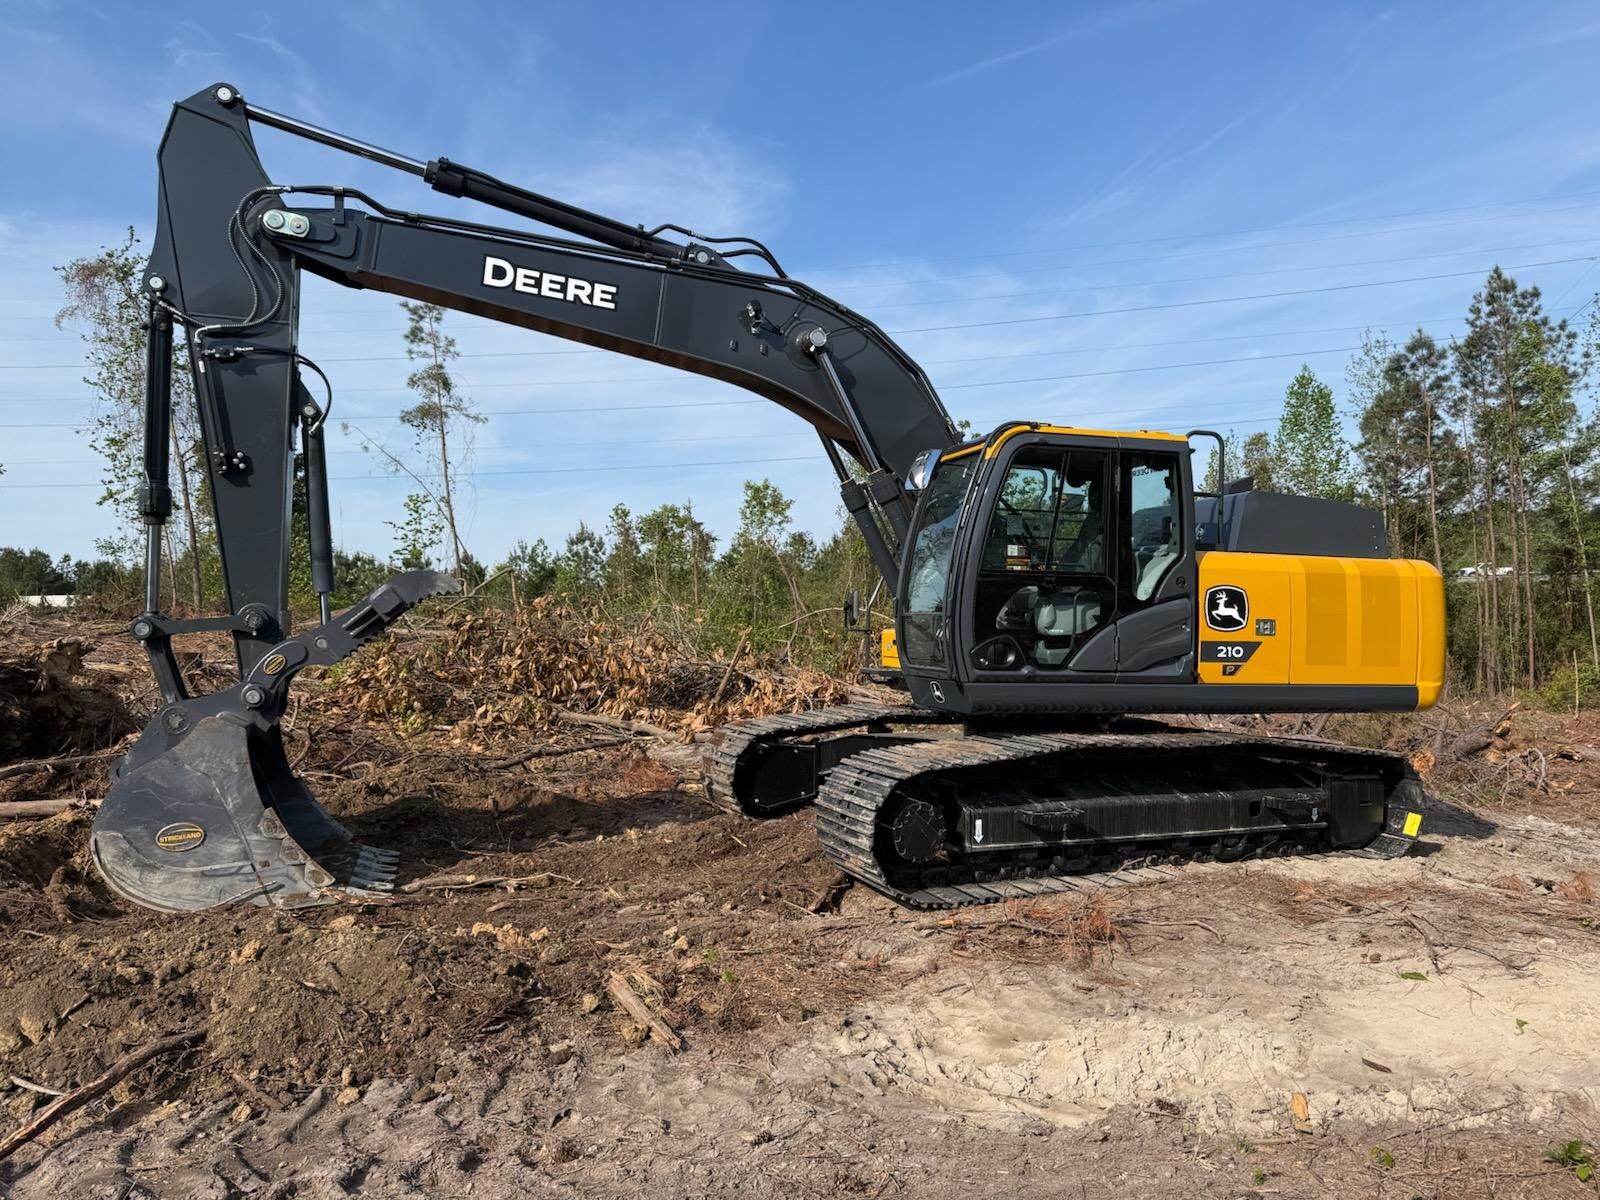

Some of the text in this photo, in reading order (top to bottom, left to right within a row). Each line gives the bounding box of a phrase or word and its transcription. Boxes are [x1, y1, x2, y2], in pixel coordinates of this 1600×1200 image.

[483, 256, 618, 310] DEERE
[1216, 646, 1244, 658] 210
[1226, 666, 1235, 675] P
